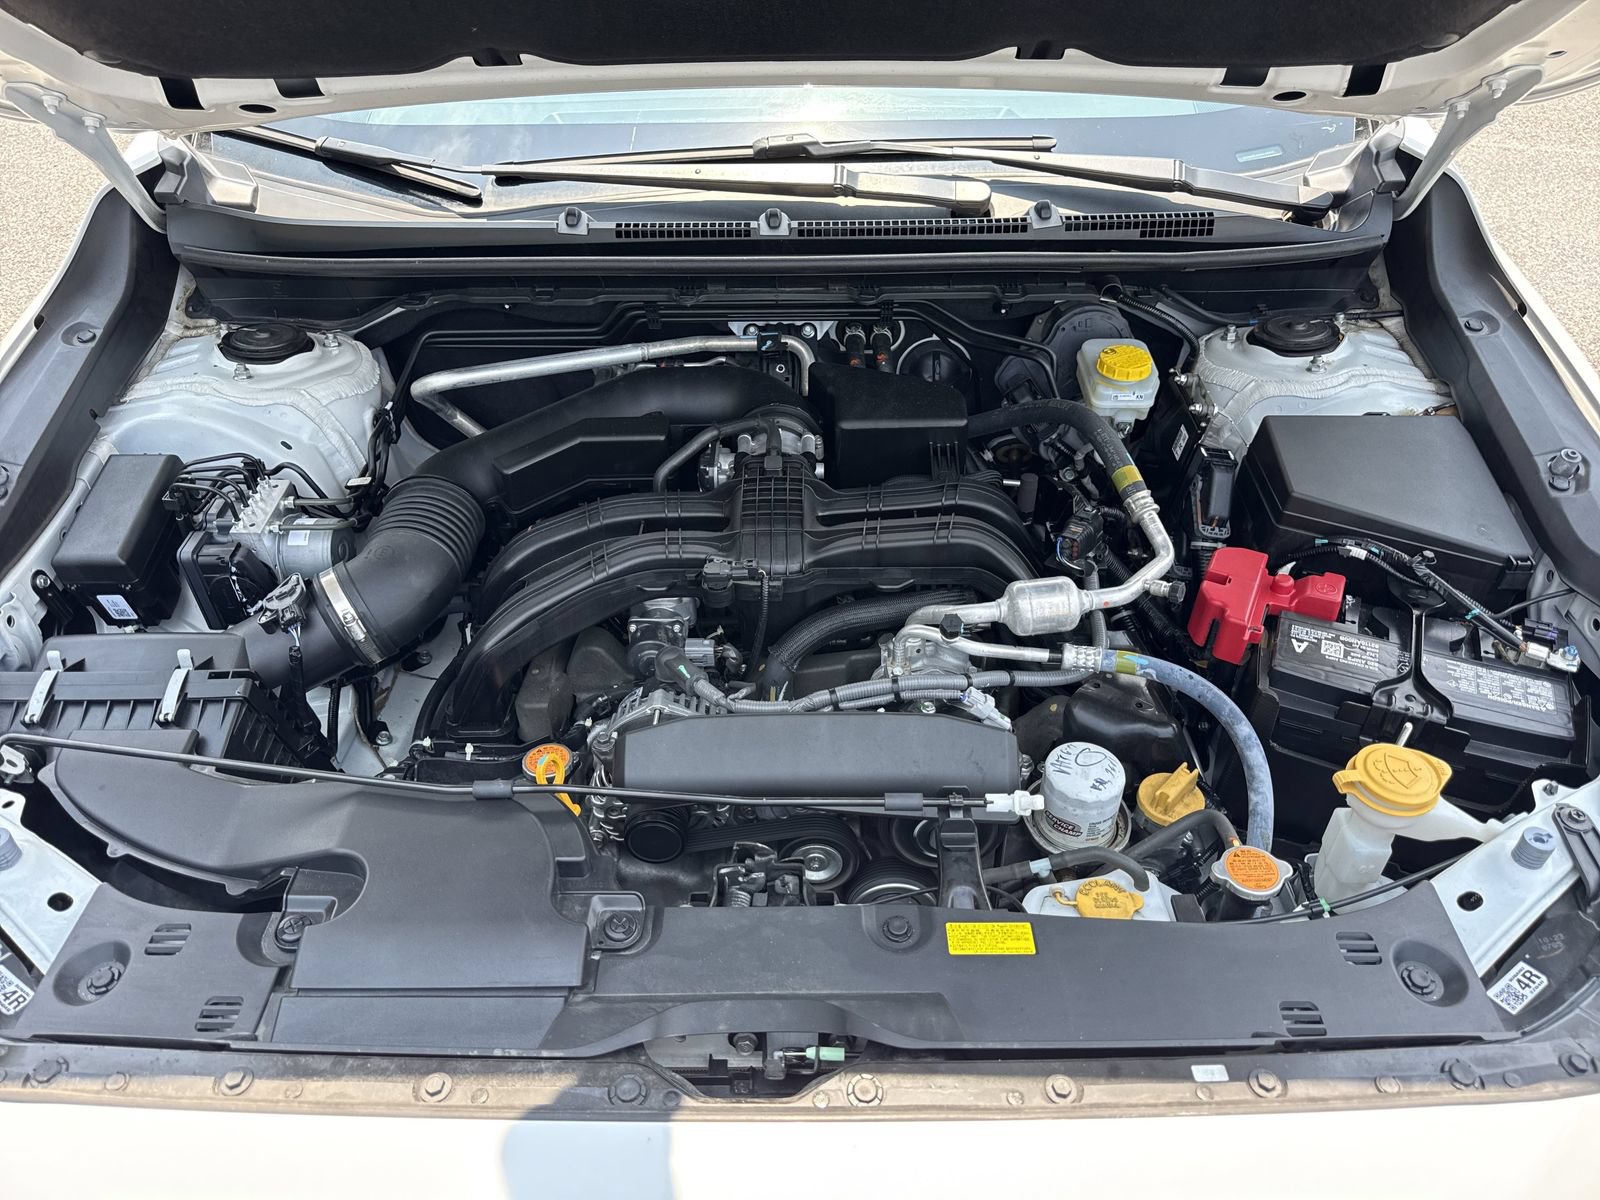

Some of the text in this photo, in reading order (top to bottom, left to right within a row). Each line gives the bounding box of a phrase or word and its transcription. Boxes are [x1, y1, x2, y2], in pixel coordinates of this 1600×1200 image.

[1045, 811, 1075, 830] SERVICE
[1053, 823, 1082, 837] CHAMP
[1516, 969, 1542, 991] 4R
[1, 990, 28, 1010] 4R
